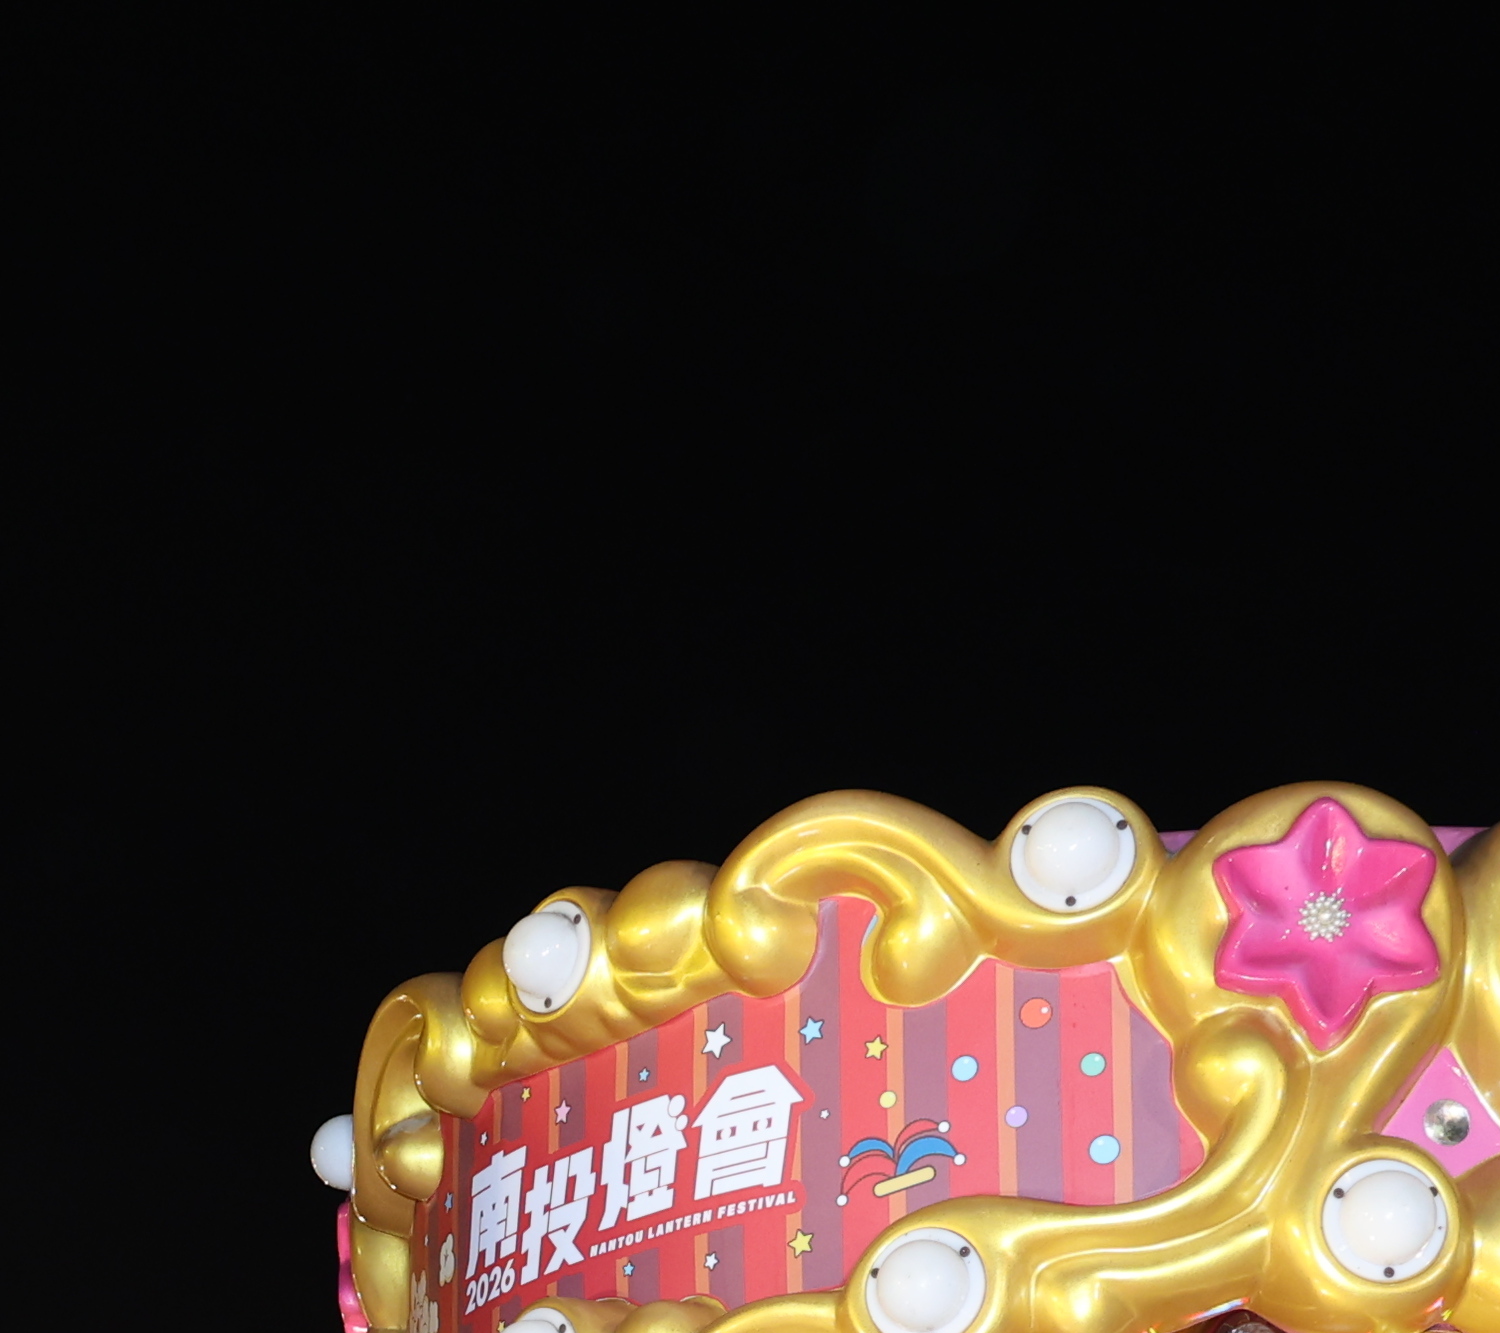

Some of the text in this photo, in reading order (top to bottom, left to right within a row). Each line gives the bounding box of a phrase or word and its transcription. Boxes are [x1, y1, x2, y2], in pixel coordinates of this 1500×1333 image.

[466, 1064, 804, 1286] 南投燈會
[590, 1190, 797, 1258] NANTOU LANTERN FESTIVAL
[465, 1258, 517, 1316] 2026
